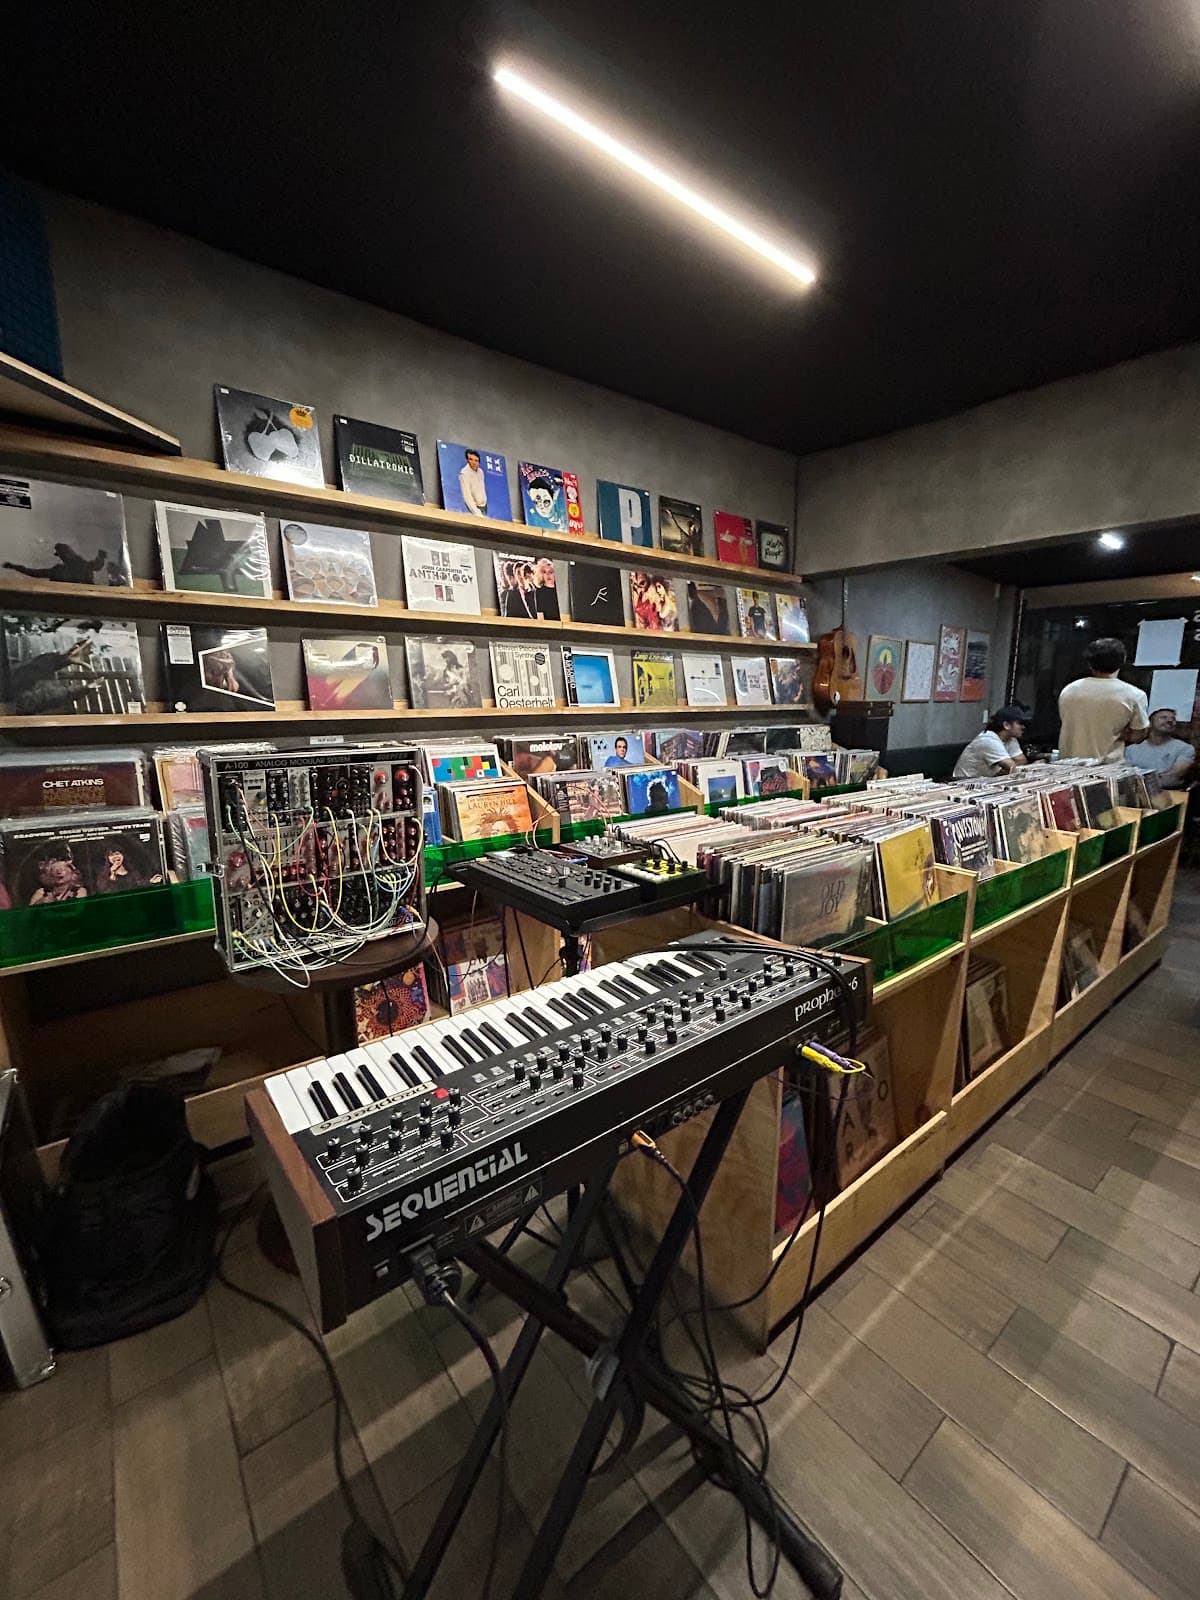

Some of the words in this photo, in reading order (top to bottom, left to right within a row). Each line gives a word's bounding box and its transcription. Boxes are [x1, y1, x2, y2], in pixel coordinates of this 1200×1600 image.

[349, 453, 414, 475] DILLATRONIC
[409, 568, 473, 584] ANTHOLOGY
[497, 685, 520, 697] Carl
[529, 741, 564, 753] molotov
[225, 761, 249, 770] A-100
[255, 759, 288, 769] ANALOG
[289, 757, 325, 767] MODULAR
[42, 780, 70, 788] CHET
[71, 778, 104, 787] ATKINS
[793, 977, 859, 1022] prophe-6
[364, 1140, 529, 1243] SEQUENTIAL
